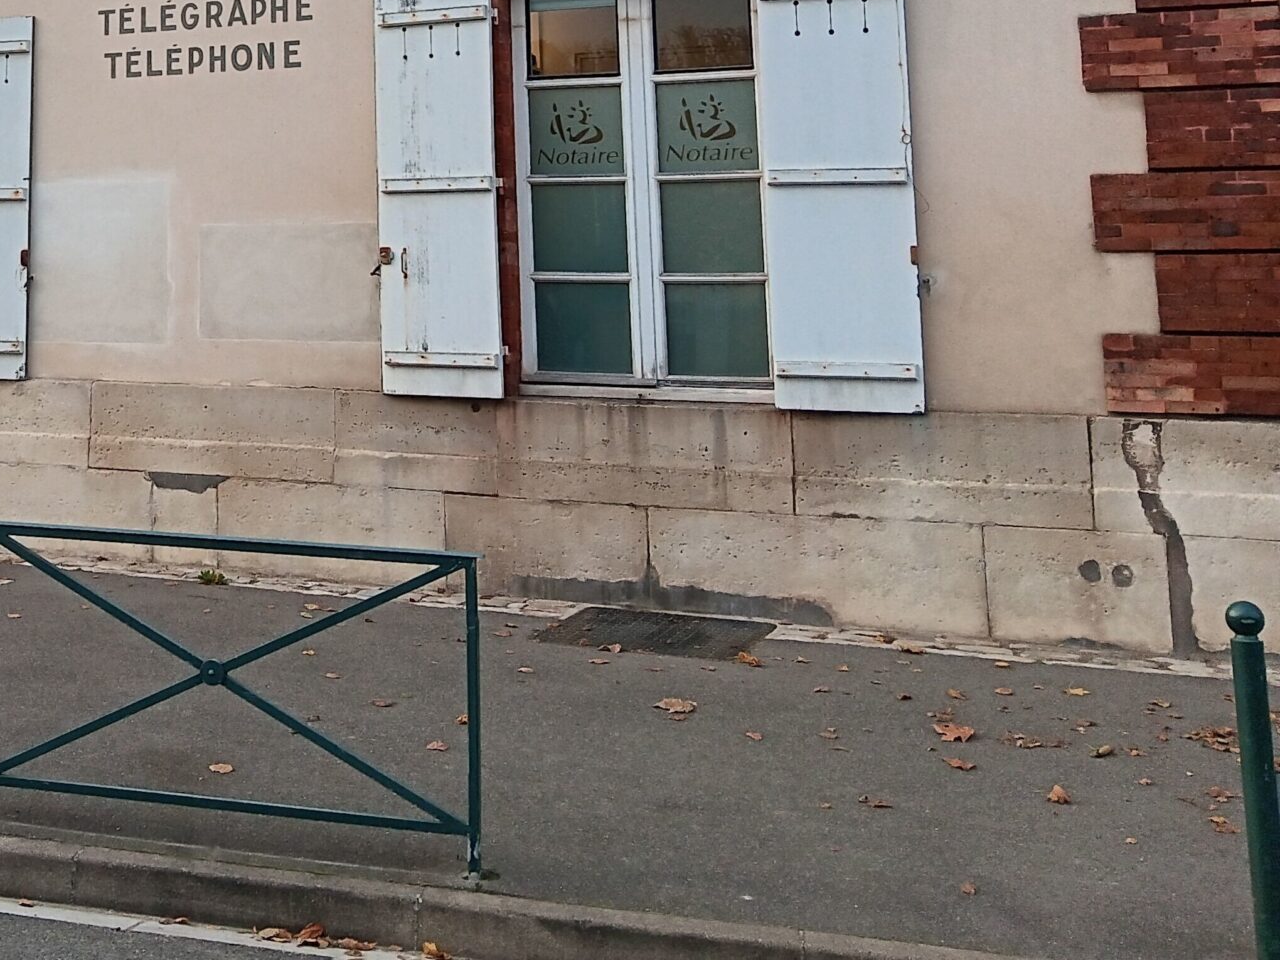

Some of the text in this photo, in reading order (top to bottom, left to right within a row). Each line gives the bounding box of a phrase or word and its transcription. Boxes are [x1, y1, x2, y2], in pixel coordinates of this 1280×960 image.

[103, 40, 302, 79] TÉLÉPHONE
[537, 146, 619, 166] Notaire
[665, 141, 754, 162] Notaire
